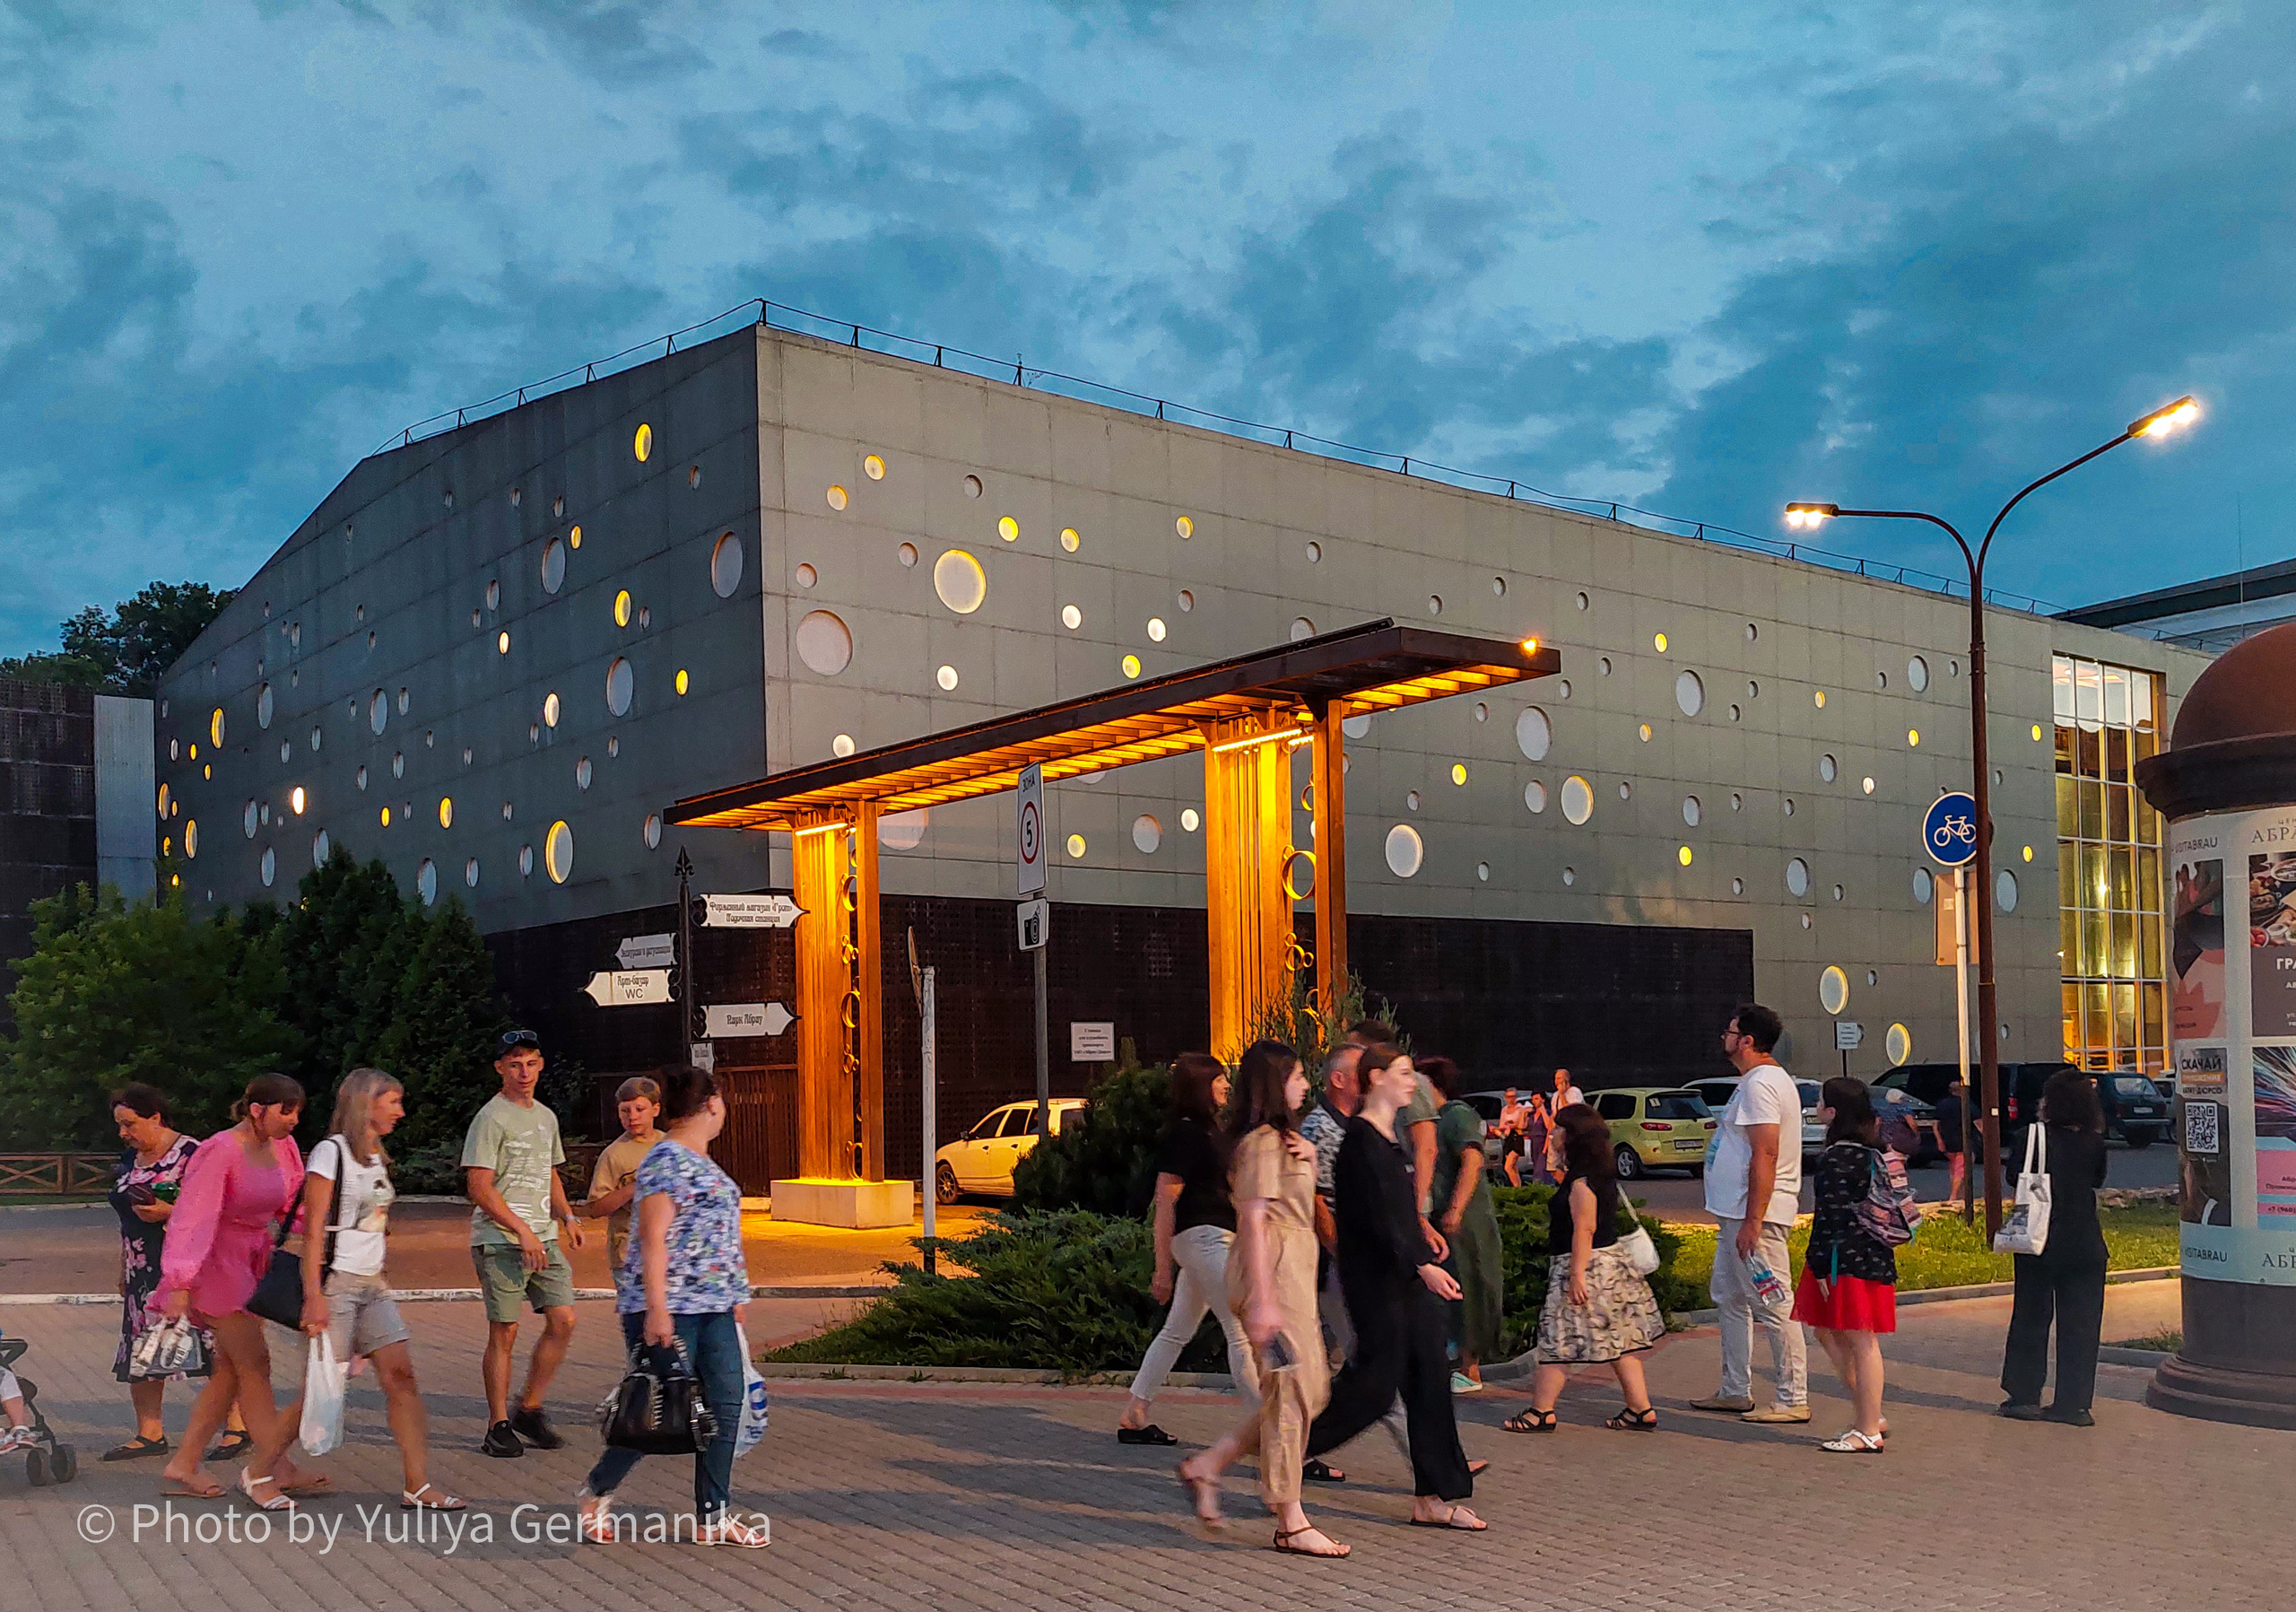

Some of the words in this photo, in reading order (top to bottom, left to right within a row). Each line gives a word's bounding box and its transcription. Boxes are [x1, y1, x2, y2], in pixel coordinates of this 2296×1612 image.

[1026, 820, 1032, 848] 5
[625, 989, 644, 999] WC
[2181, 1055, 2222, 1070] СКАЧАЙ
